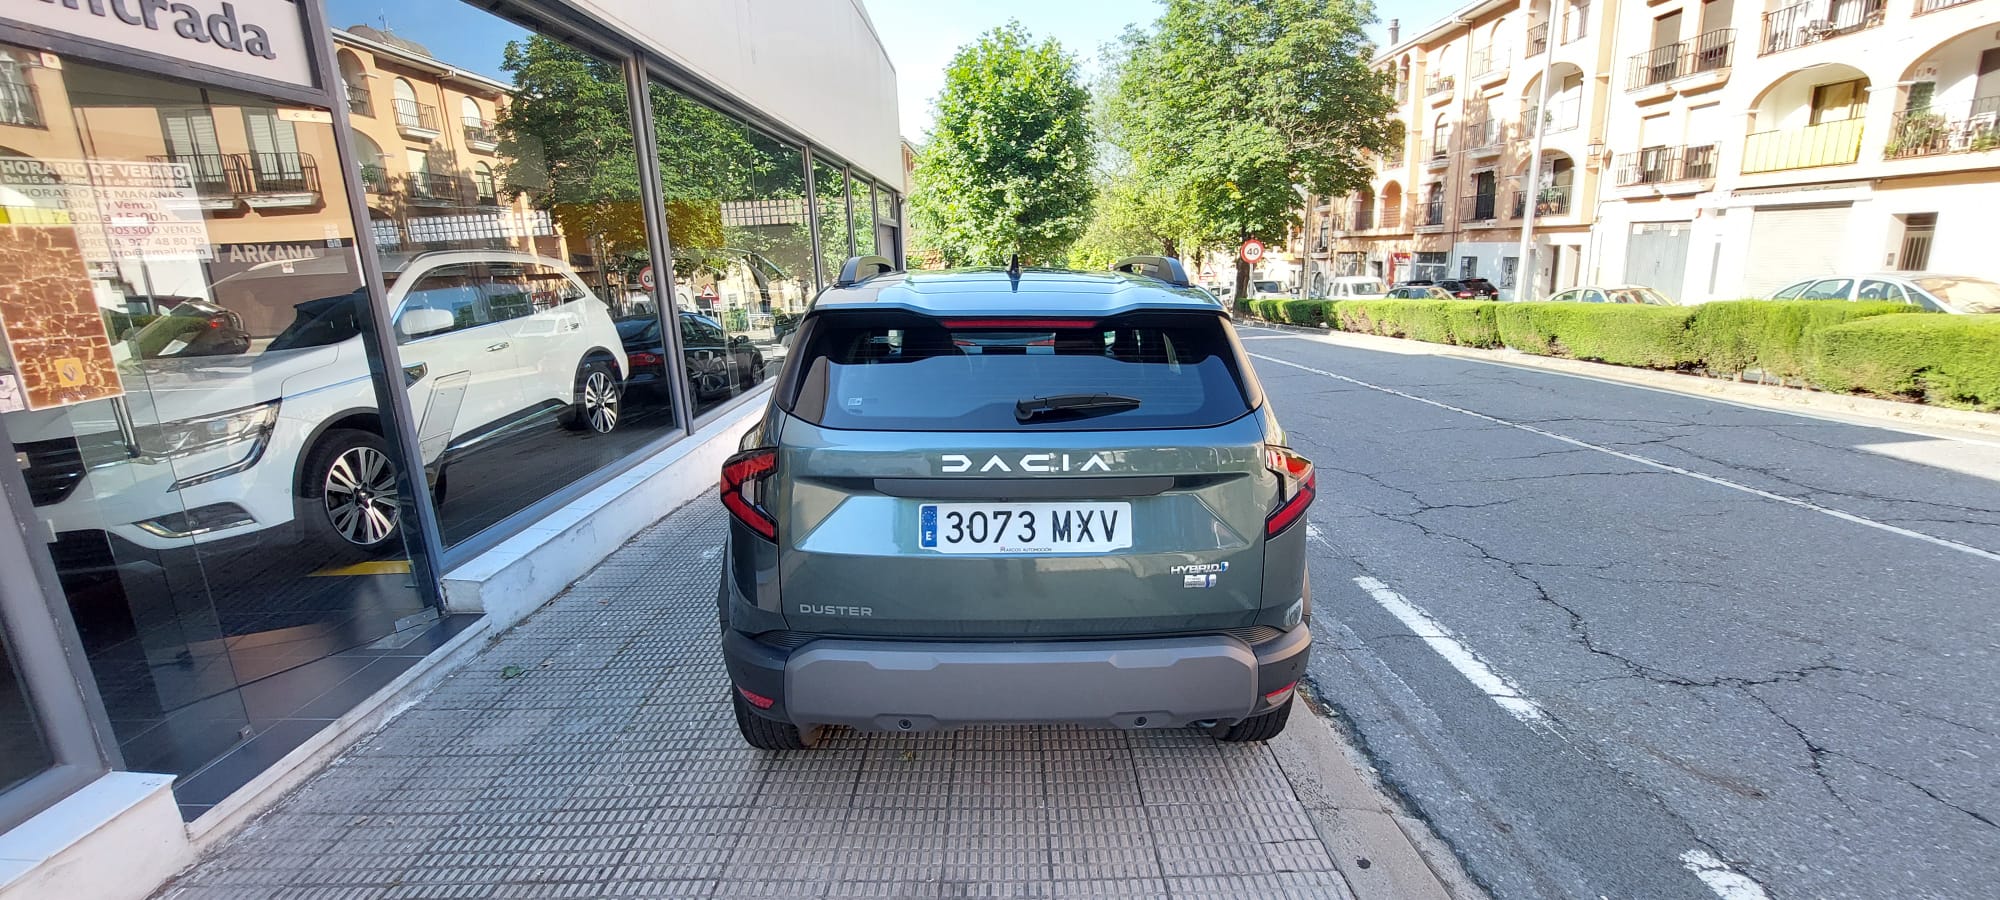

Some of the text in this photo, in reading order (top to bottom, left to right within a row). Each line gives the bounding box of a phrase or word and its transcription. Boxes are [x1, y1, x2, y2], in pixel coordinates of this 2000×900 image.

[40, 0, 277, 60] trada
[0, 161, 186, 179] HORARIO DE VERANO
[4, 174, 23, 184] Del
[26, 175, 39, 184] 15
[230, 243, 317, 263] ARKANA
[1246, 247, 1260, 256] 40
[941, 453, 1111, 473] DACIA
[925, 510, 1118, 544] E 3073 MXV
[1170, 563, 1221, 575] HYBRID
[799, 603, 873, 617] DUSTER
